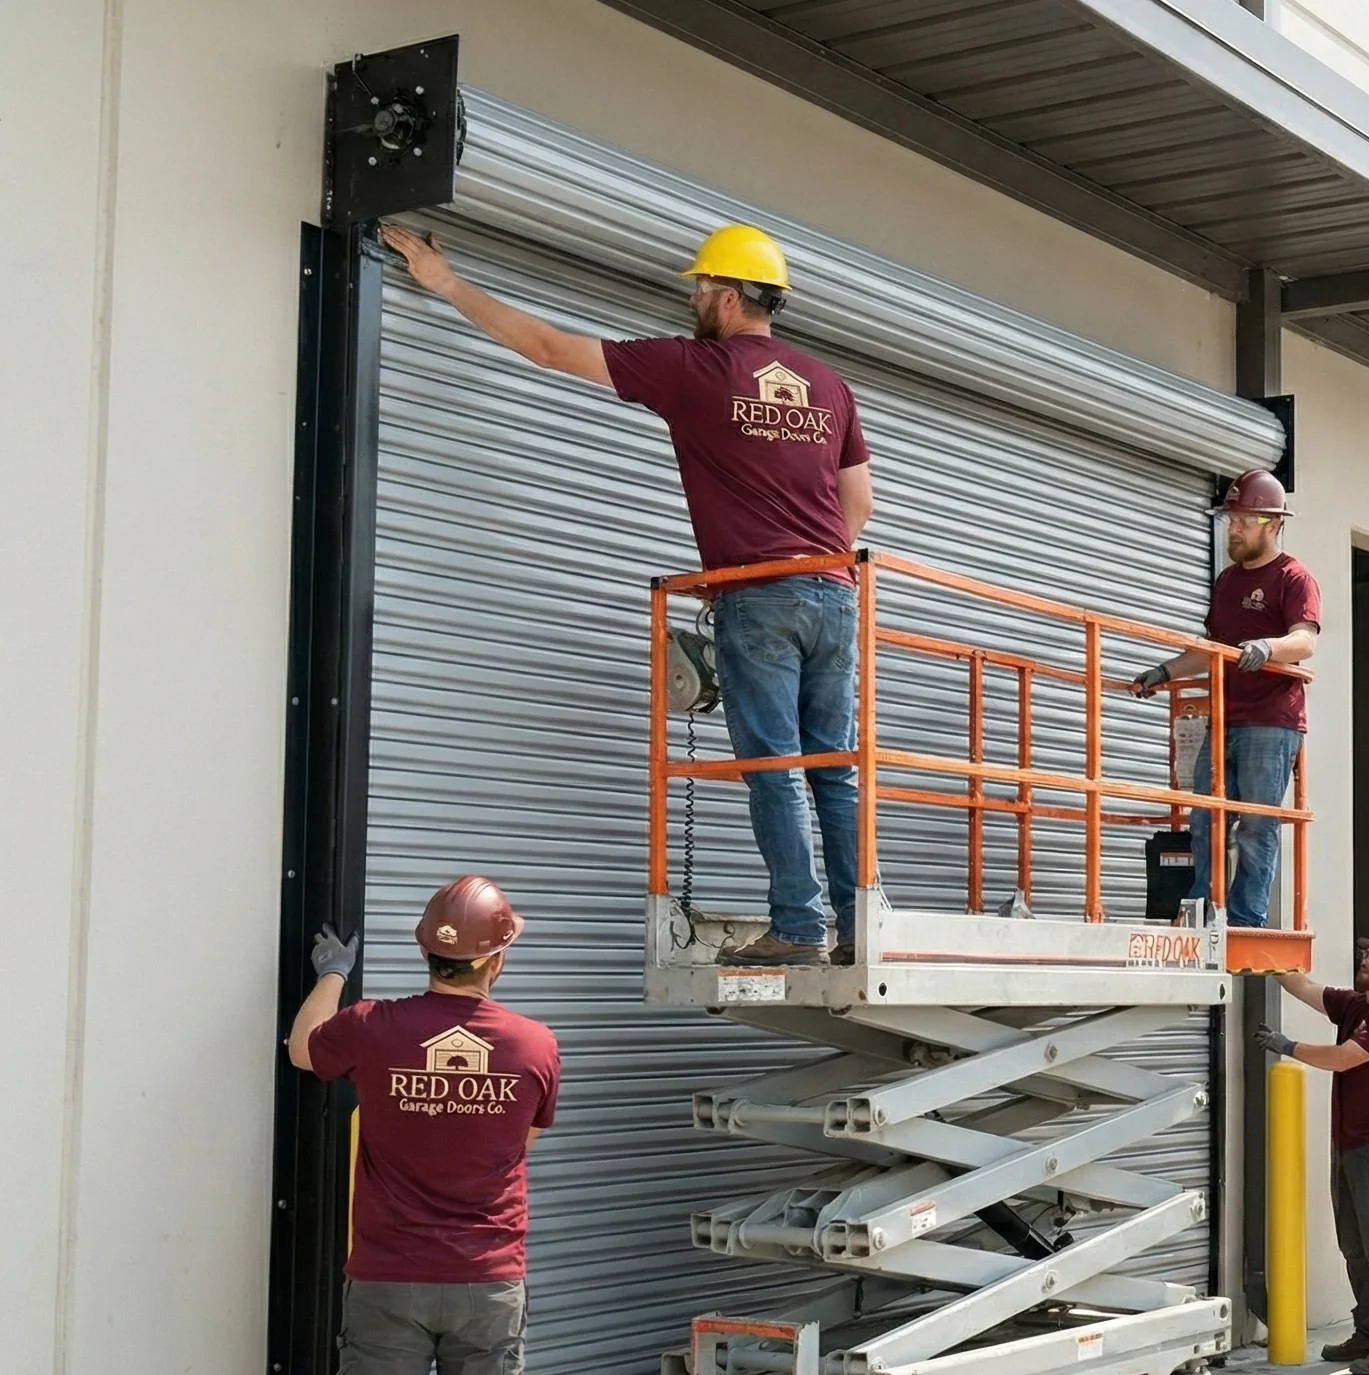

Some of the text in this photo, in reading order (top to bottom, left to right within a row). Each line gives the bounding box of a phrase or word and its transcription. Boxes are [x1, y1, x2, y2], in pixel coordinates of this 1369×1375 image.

[731, 401, 833, 435] RED OAK
[389, 1073, 519, 1102] RED OAK
[399, 1098, 444, 1117] Garage
[486, 1101, 506, 1115] Co.
